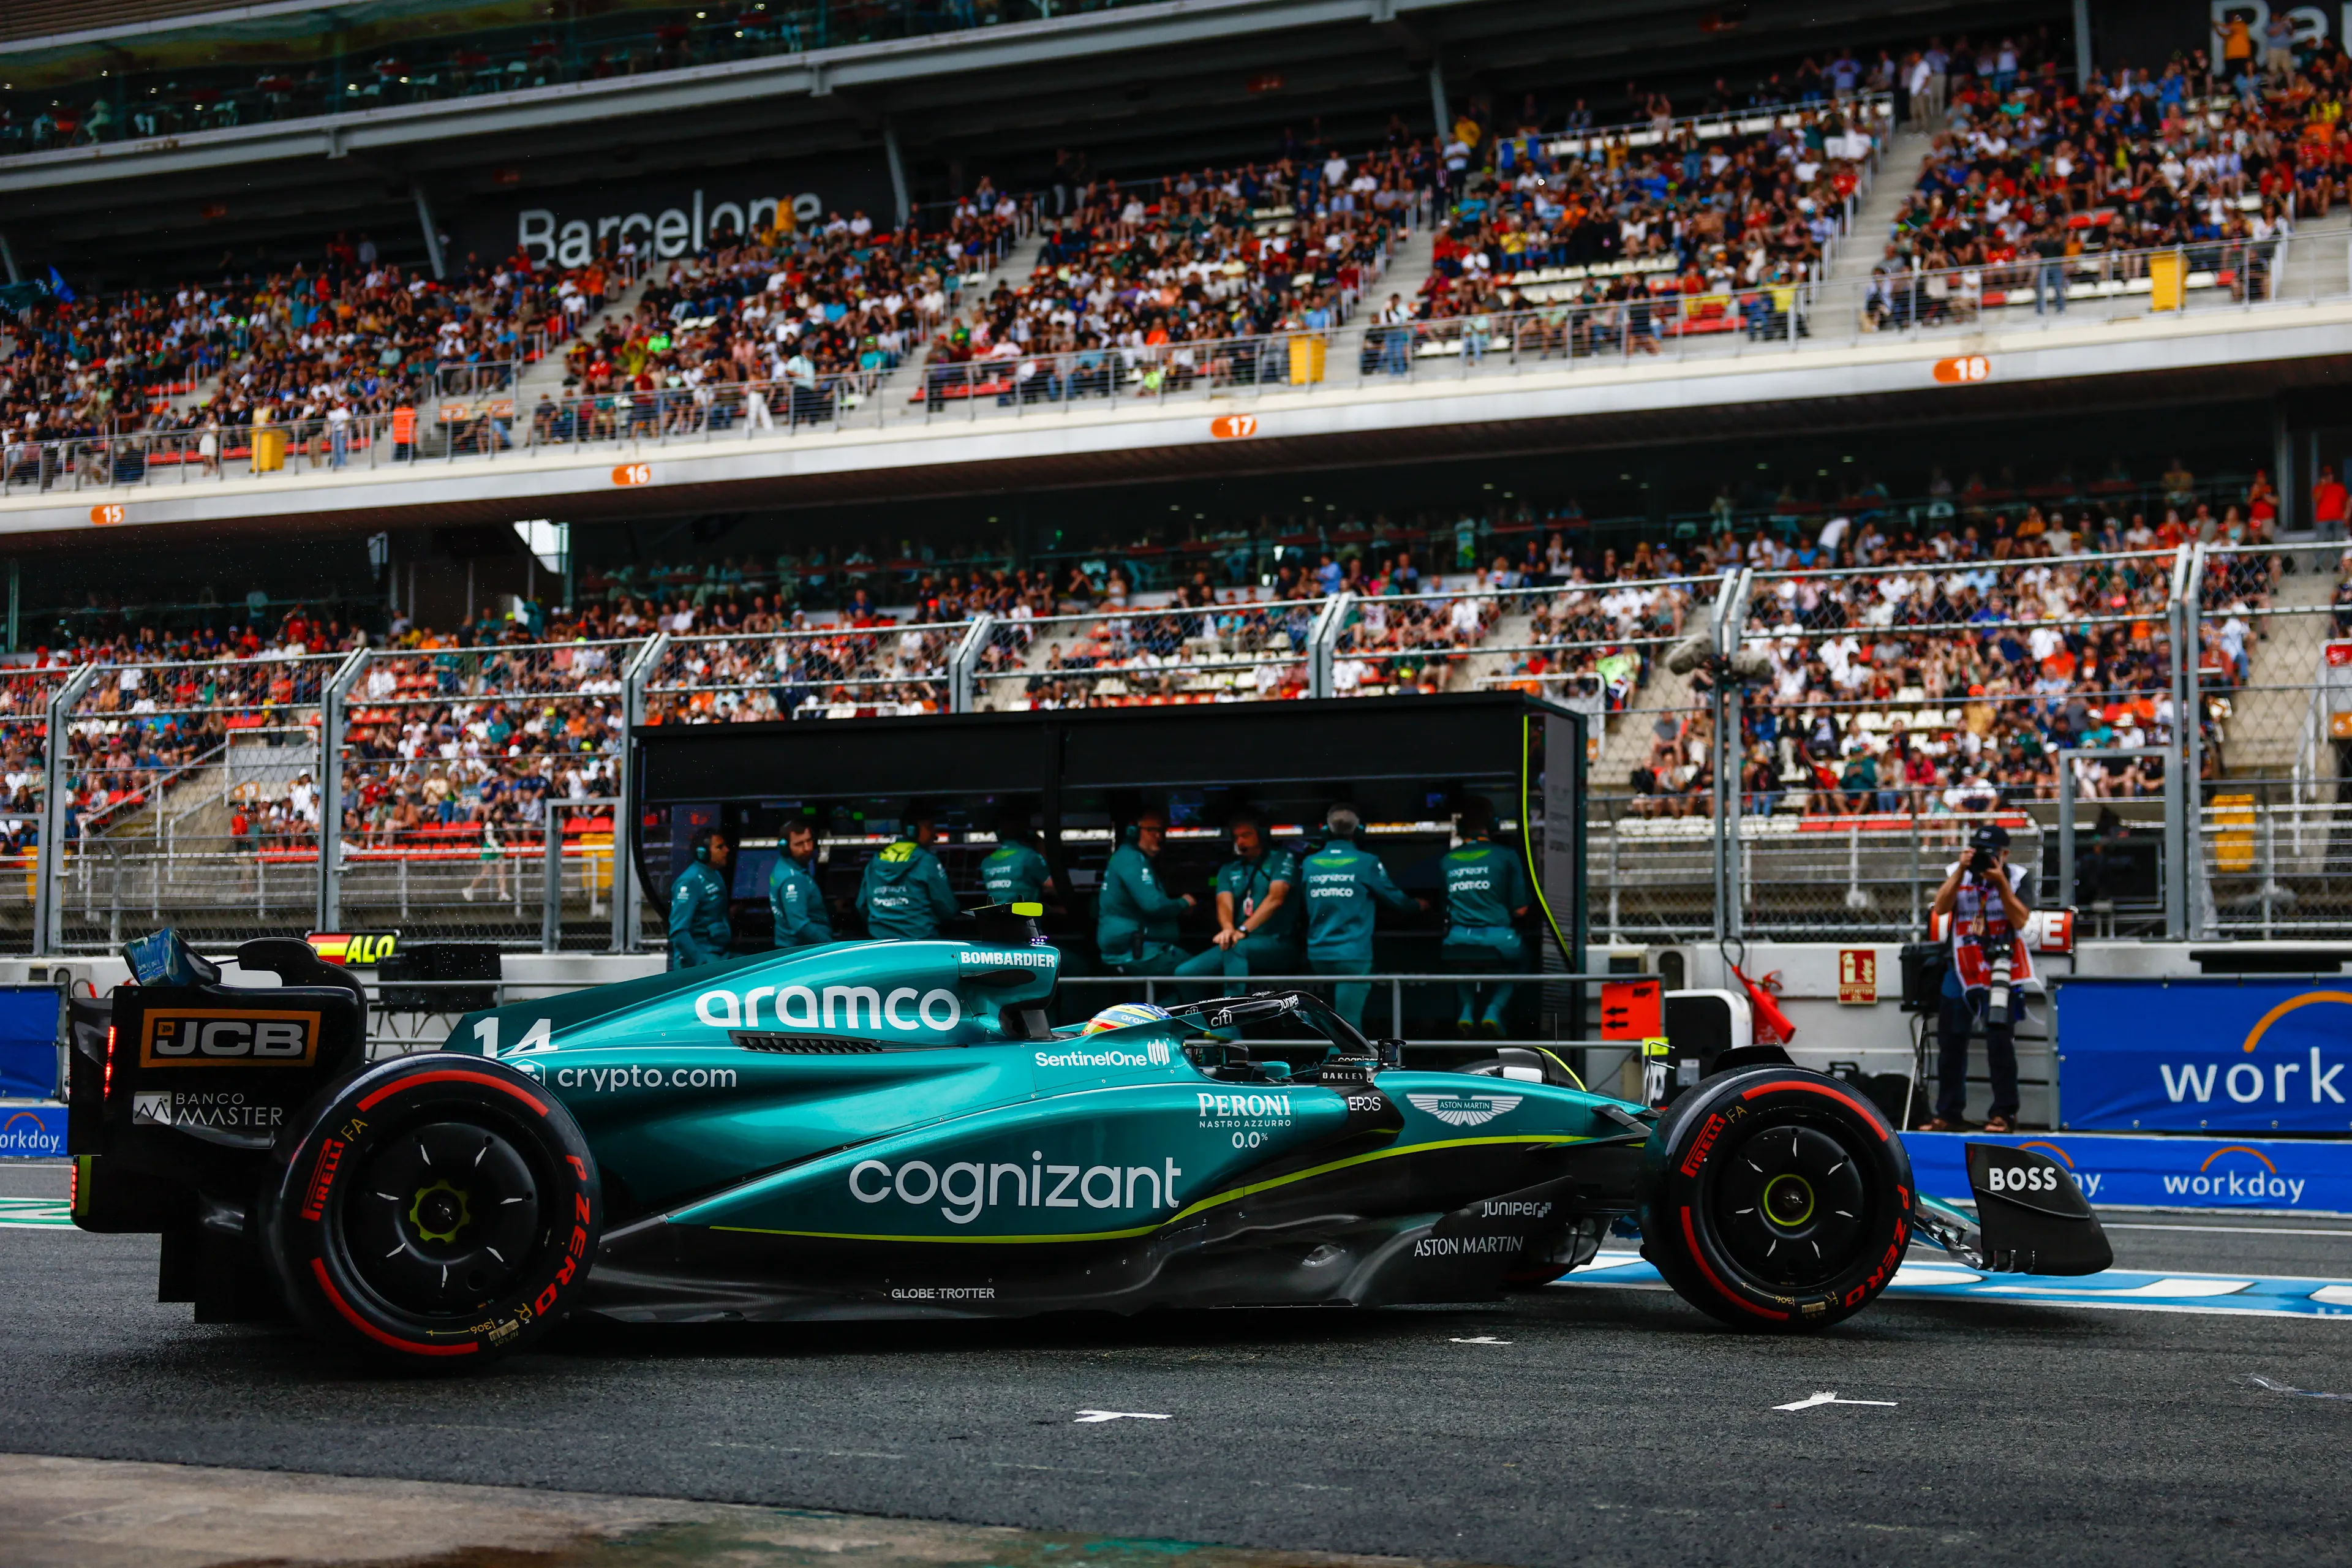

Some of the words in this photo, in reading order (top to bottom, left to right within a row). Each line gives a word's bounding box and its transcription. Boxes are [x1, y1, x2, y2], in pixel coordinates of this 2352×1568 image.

[1954, 358, 1985, 381] 18
[1227, 416, 1256, 437] 17
[627, 464, 650, 484] 16
[103, 505, 124, 524] 15
[1310, 887, 1354, 898] aramco
[345, 935, 396, 963] ALO
[960, 951, 1055, 968] BOMBARDIER
[695, 985, 961, 1031] aramco
[1210, 1008, 1232, 1027] citi
[156, 1022, 304, 1056] JCB
[473, 1017, 559, 1060] 14
[1035, 1050, 1147, 1068] SentinelOne
[557, 1064, 737, 1092] crypto.com
[2159, 1046, 2346, 1104] work
[176, 1093, 244, 1104] BANCO
[1196, 1093, 1291, 1117] PERONI
[176, 1107, 284, 1126] MASTER
[1725, 1105, 1747, 1123] FA
[341, 1118, 369, 1143] FA
[1232, 1131, 1268, 1149] 0.0%
[1681, 1113, 1726, 1178] PIRELLI
[301, 1138, 345, 1222] PIRELLI
[849, 1150, 1182, 1224] cognizant
[1989, 1167, 2057, 1191] BOSS
[2163, 1170, 2305, 1205] workday
[1414, 1238, 1460, 1257] ASTON
[1462, 1236, 1523, 1254] MARTIN
